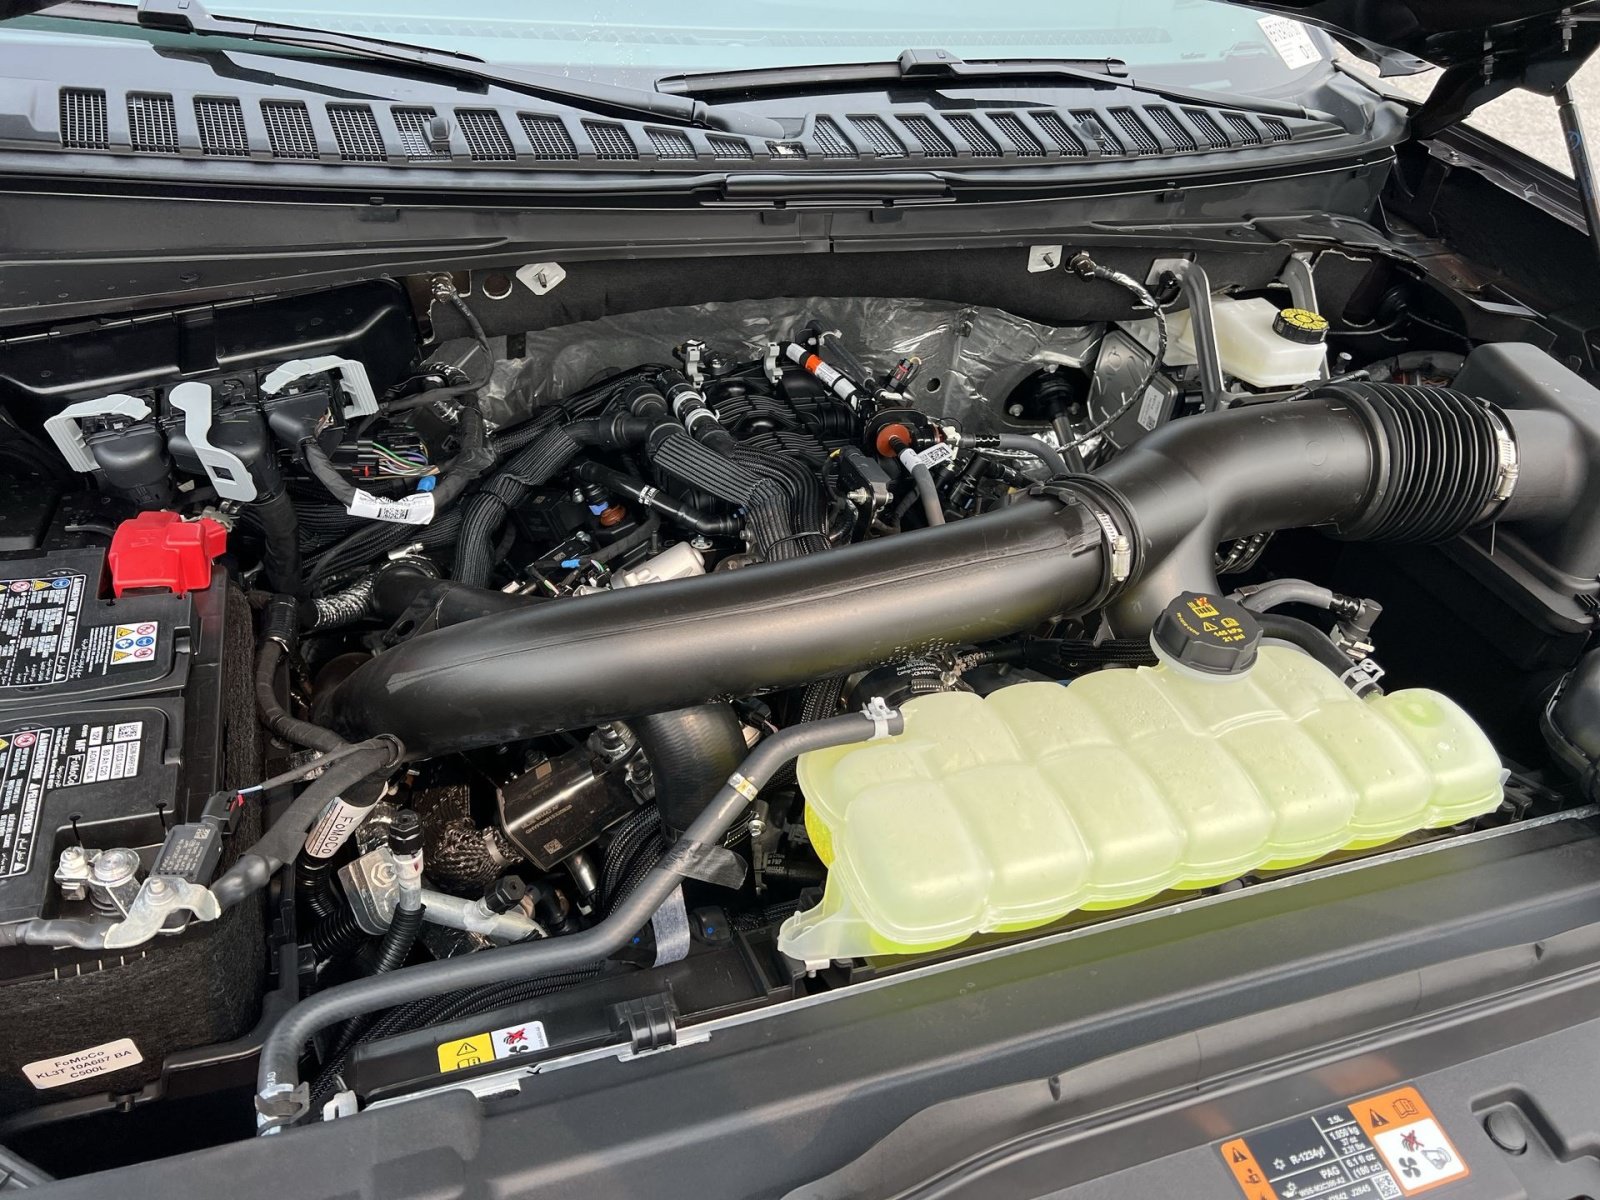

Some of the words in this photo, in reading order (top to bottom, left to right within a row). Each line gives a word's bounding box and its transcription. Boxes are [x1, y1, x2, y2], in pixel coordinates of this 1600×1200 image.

[68, 756, 81, 784] FoMoCo
[322, 816, 353, 853] FoMoCo
[36, 1068, 65, 1079] KL3T
[114, 1050, 132, 1058] BA
[54, 1051, 105, 1067] FoMoCo
[70, 1066, 107, 1079] C500L
[1348, 1126, 1360, 1135] kg
[1289, 1145, 1326, 1165] R-1234yf
[1346, 1156, 1358, 1168] 6.1
[1319, 1165, 1340, 1180] PAG
[1370, 1162, 1383, 1172] cc)
